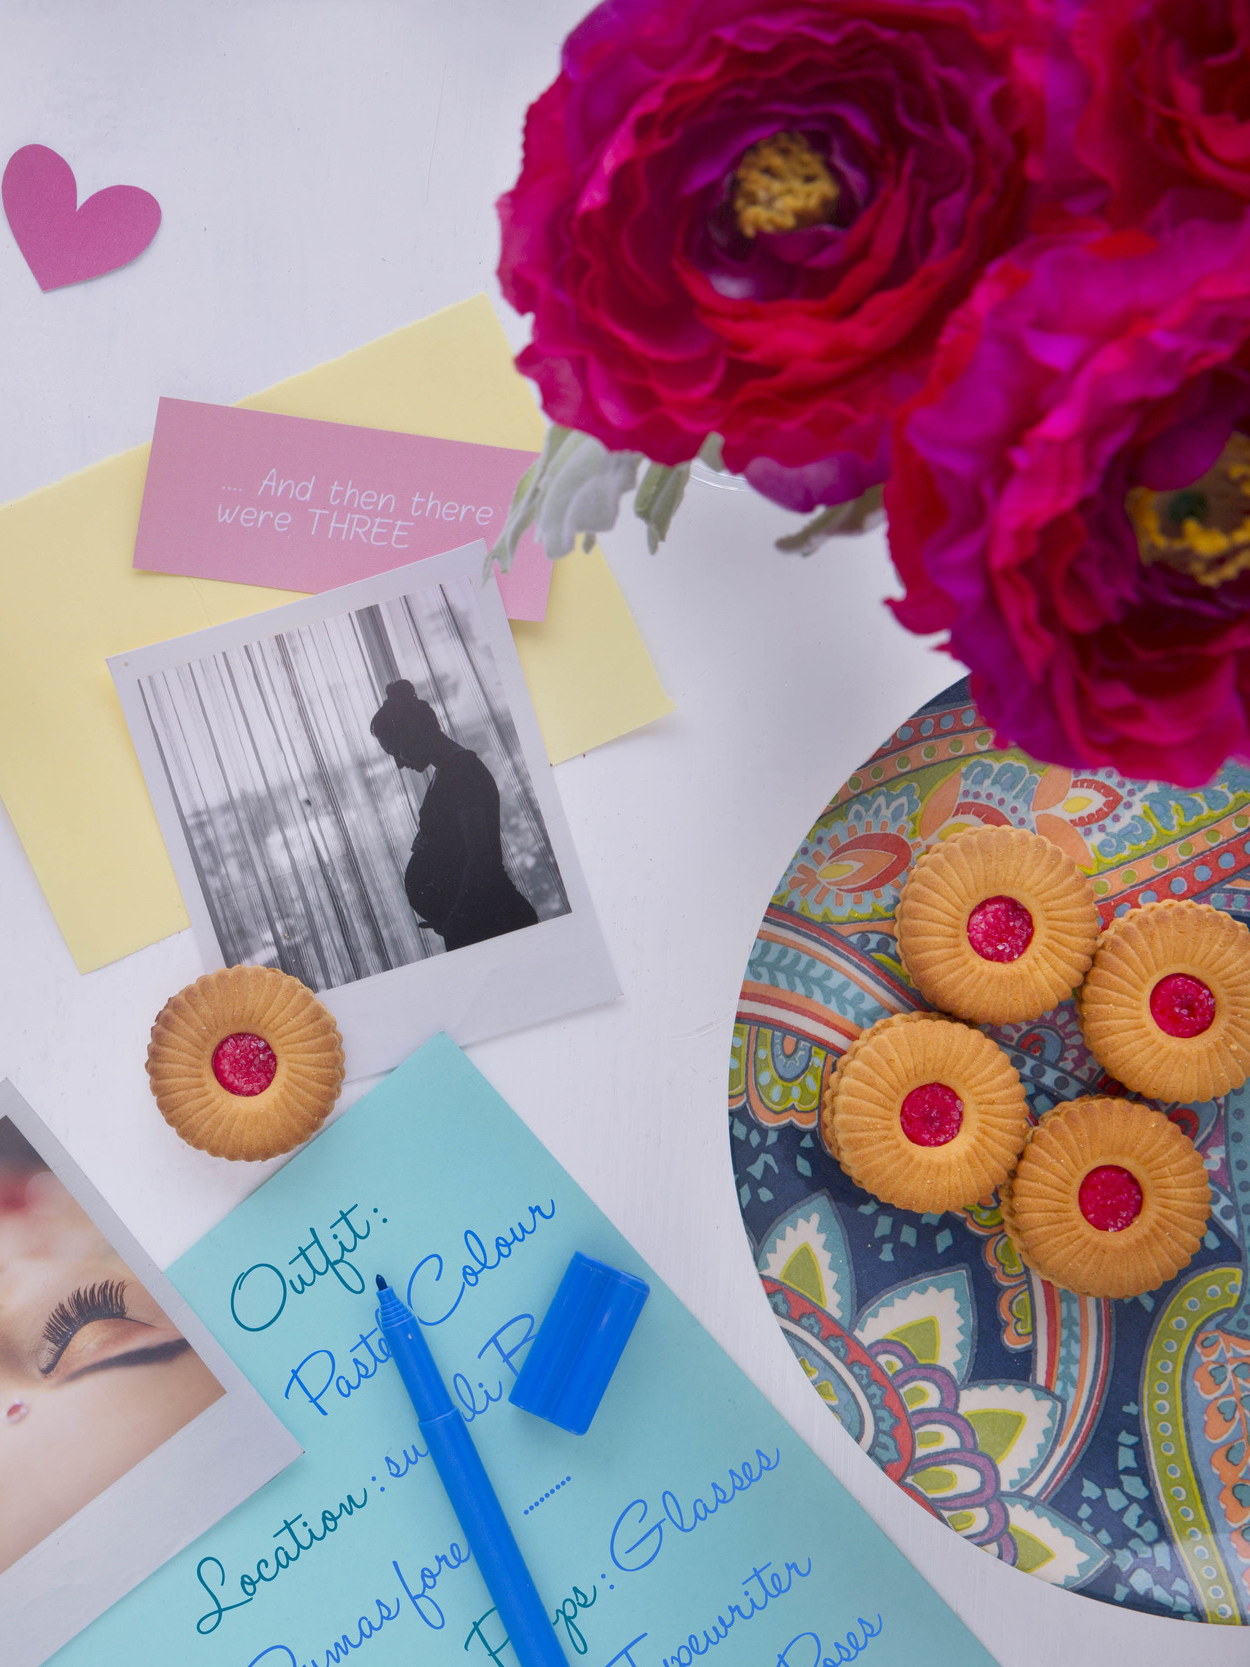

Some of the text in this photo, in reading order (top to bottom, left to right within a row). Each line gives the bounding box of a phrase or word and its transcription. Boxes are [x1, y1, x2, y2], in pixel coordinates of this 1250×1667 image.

[217, 504, 414, 549] were THREE
[258, 468, 315, 501] And
[329, 480, 396, 513] then
[410, 491, 494, 526] there
[407, 1199, 556, 1326] Colour
[610, 1447, 781, 1572] Glasses
